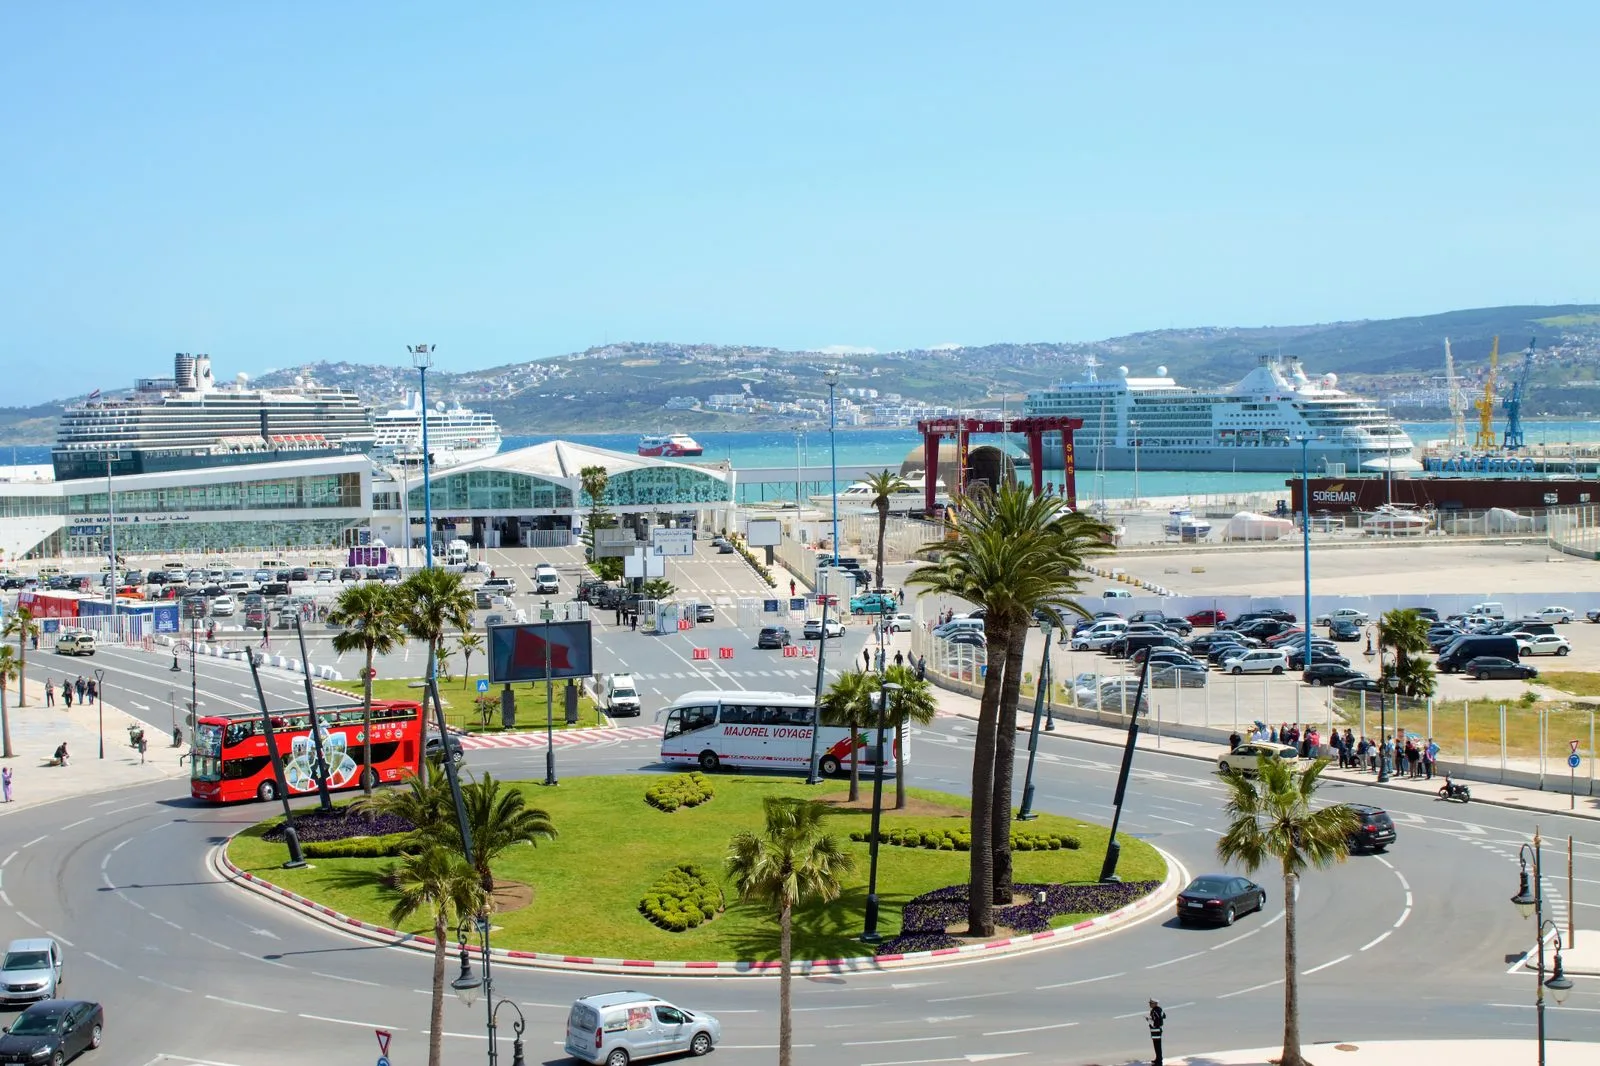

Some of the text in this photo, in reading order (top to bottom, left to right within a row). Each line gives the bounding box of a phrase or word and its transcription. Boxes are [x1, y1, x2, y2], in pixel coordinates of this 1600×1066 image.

[1313, 491, 1356, 501] SOREMAR
[723, 726, 813, 739] MAJOREL VOYAGE
